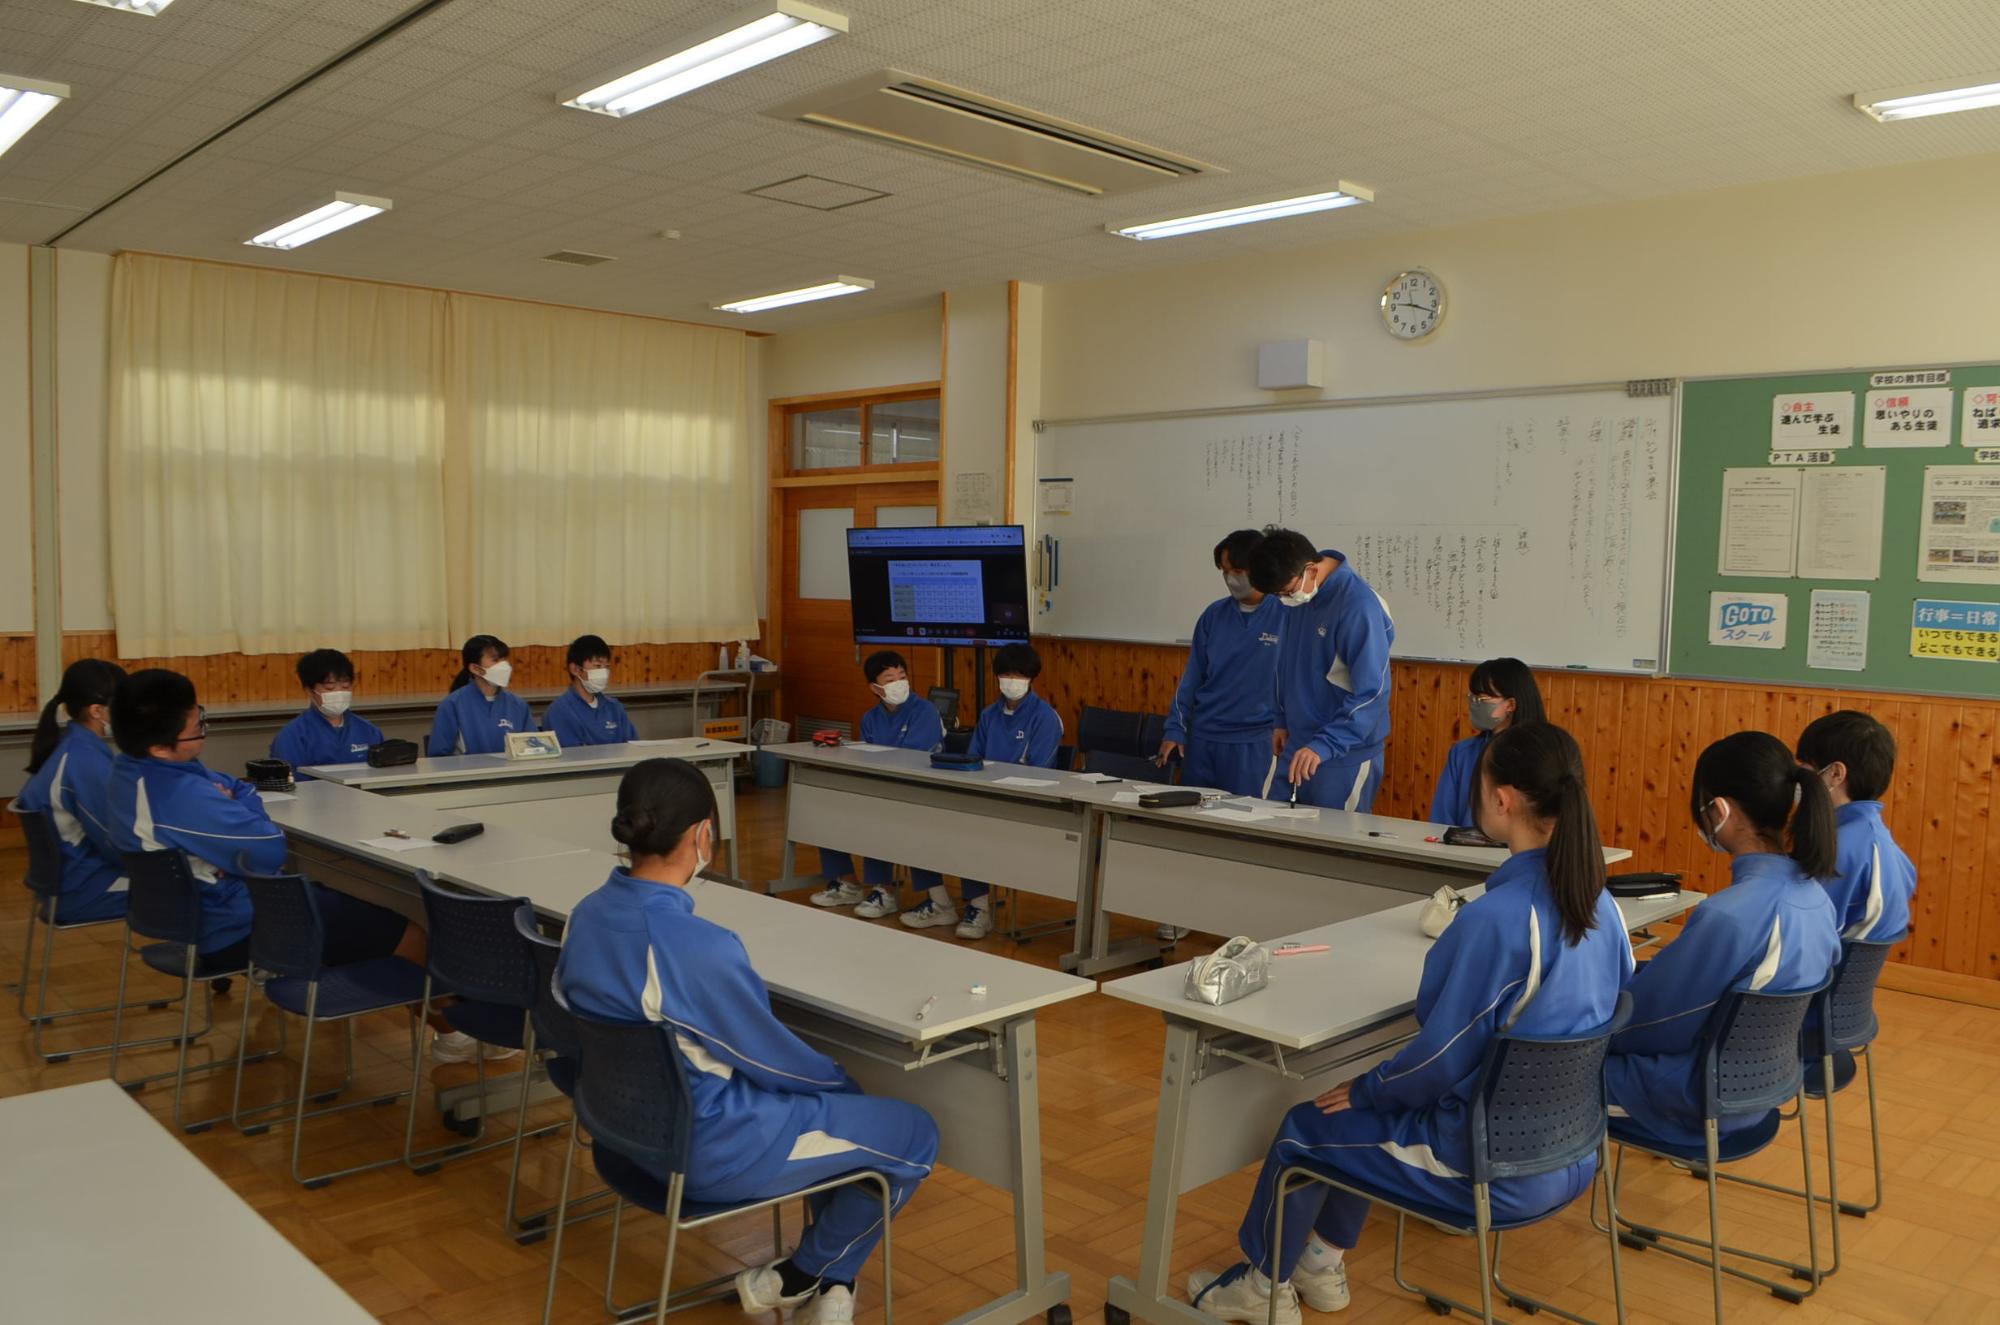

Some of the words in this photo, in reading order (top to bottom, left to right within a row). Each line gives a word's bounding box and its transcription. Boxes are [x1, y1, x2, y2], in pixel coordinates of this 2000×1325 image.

[1401, 282, 1408, 290] 11
[1410, 279, 1418, 287] 12
[1393, 291, 1400, 300] 10
[1429, 287, 1435, 296] 2
[1391, 304, 1396, 312] 9
[1431, 300, 1437, 308] 3
[1393, 315, 1399, 323] 8
[1428, 312, 1434, 320] 4
[1401, 322, 1407, 331] 7
[1410, 325, 1416, 333] 6
[1421, 320, 1427, 329] 5
[1874, 373, 1946, 385] 学校の教育目標
[1780, 413, 1834, 425] 進んで学ぶ
[1875, 409, 1934, 420] 思いやりの
[1818, 424, 1841, 435] 生徒
[1890, 421, 1938, 431] ある生徒
[1722, 629, 1772, 642] スクール
[1918, 629, 1998, 643] いつでもできる
[1918, 643, 1997, 657] どこでもできる
